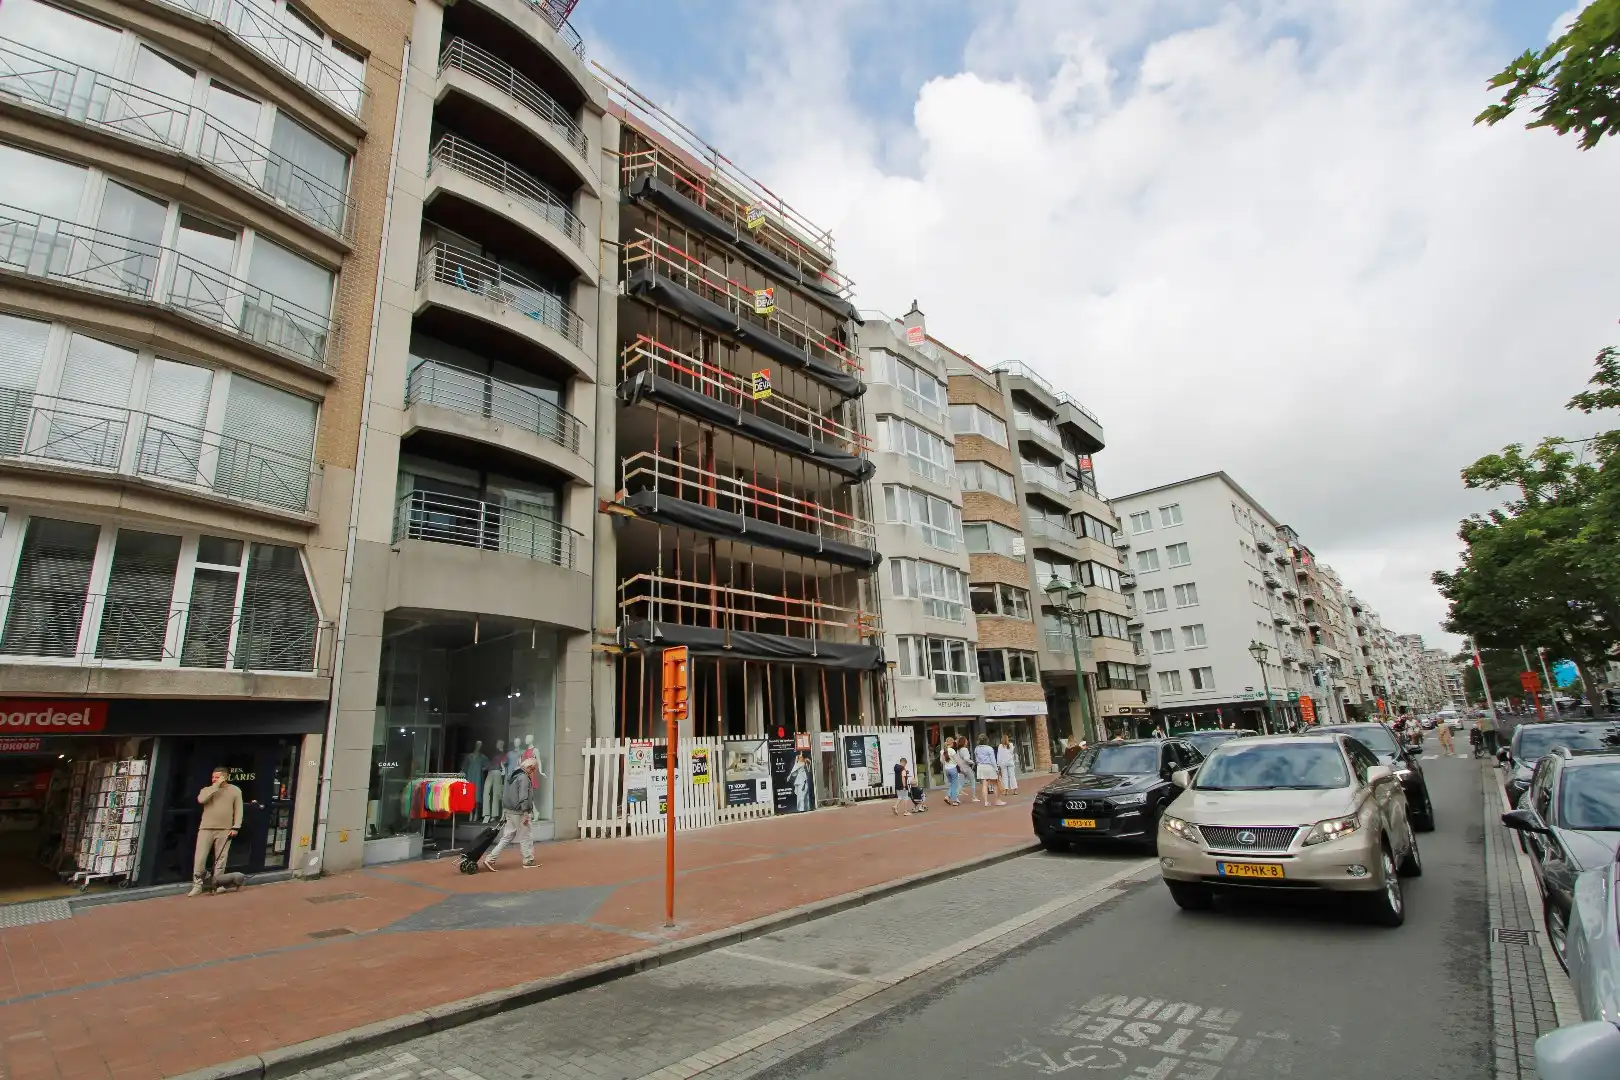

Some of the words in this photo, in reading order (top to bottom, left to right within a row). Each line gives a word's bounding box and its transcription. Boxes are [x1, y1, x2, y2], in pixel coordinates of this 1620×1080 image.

[754, 380, 772, 392] DEVA
[692, 761, 708, 774] DEVA
[227, 772, 256, 782] LARIS
[1226, 864, 1278, 876] 27-PHK-8
